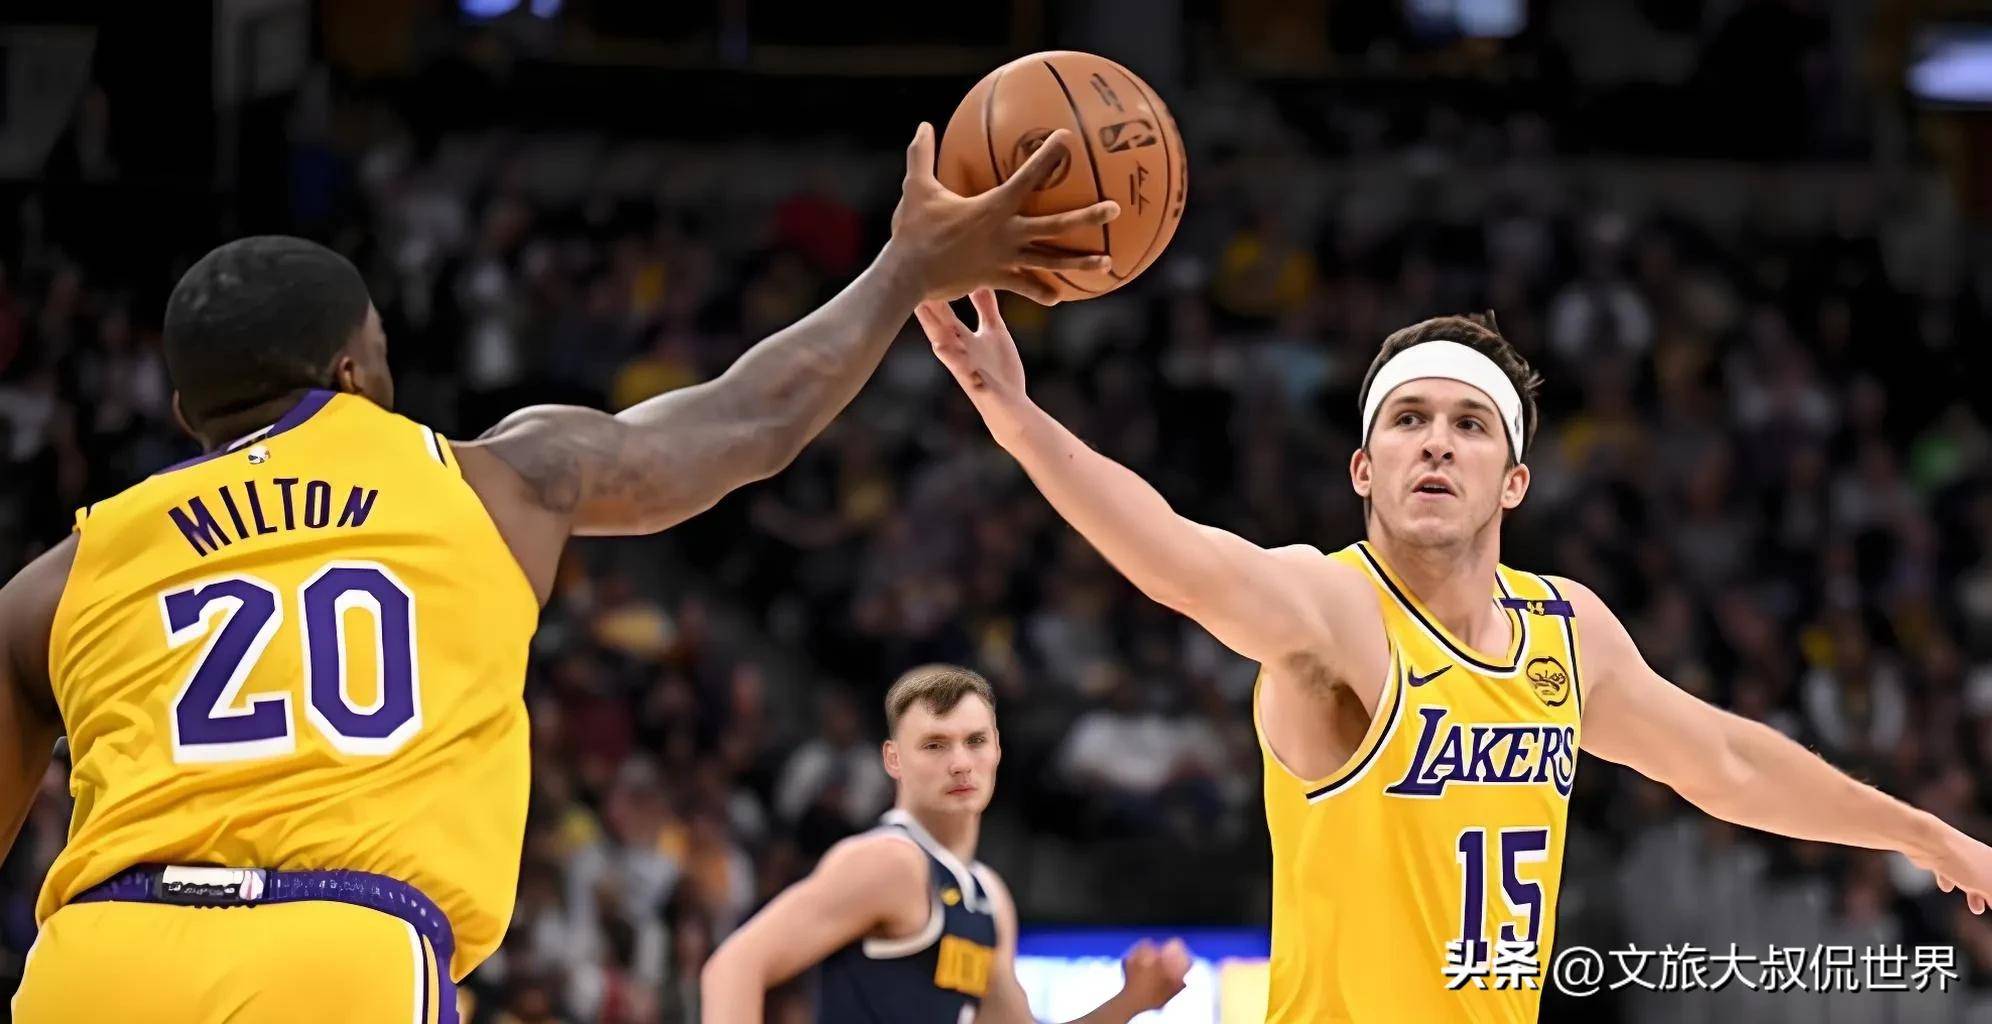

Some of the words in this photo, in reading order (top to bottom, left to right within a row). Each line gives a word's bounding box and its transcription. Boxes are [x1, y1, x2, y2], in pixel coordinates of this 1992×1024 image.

[168, 477, 379, 557] MILTON
[159, 560, 422, 764] 20
[1384, 705, 1577, 798] LAKERS
[1456, 826, 1549, 966] 15
